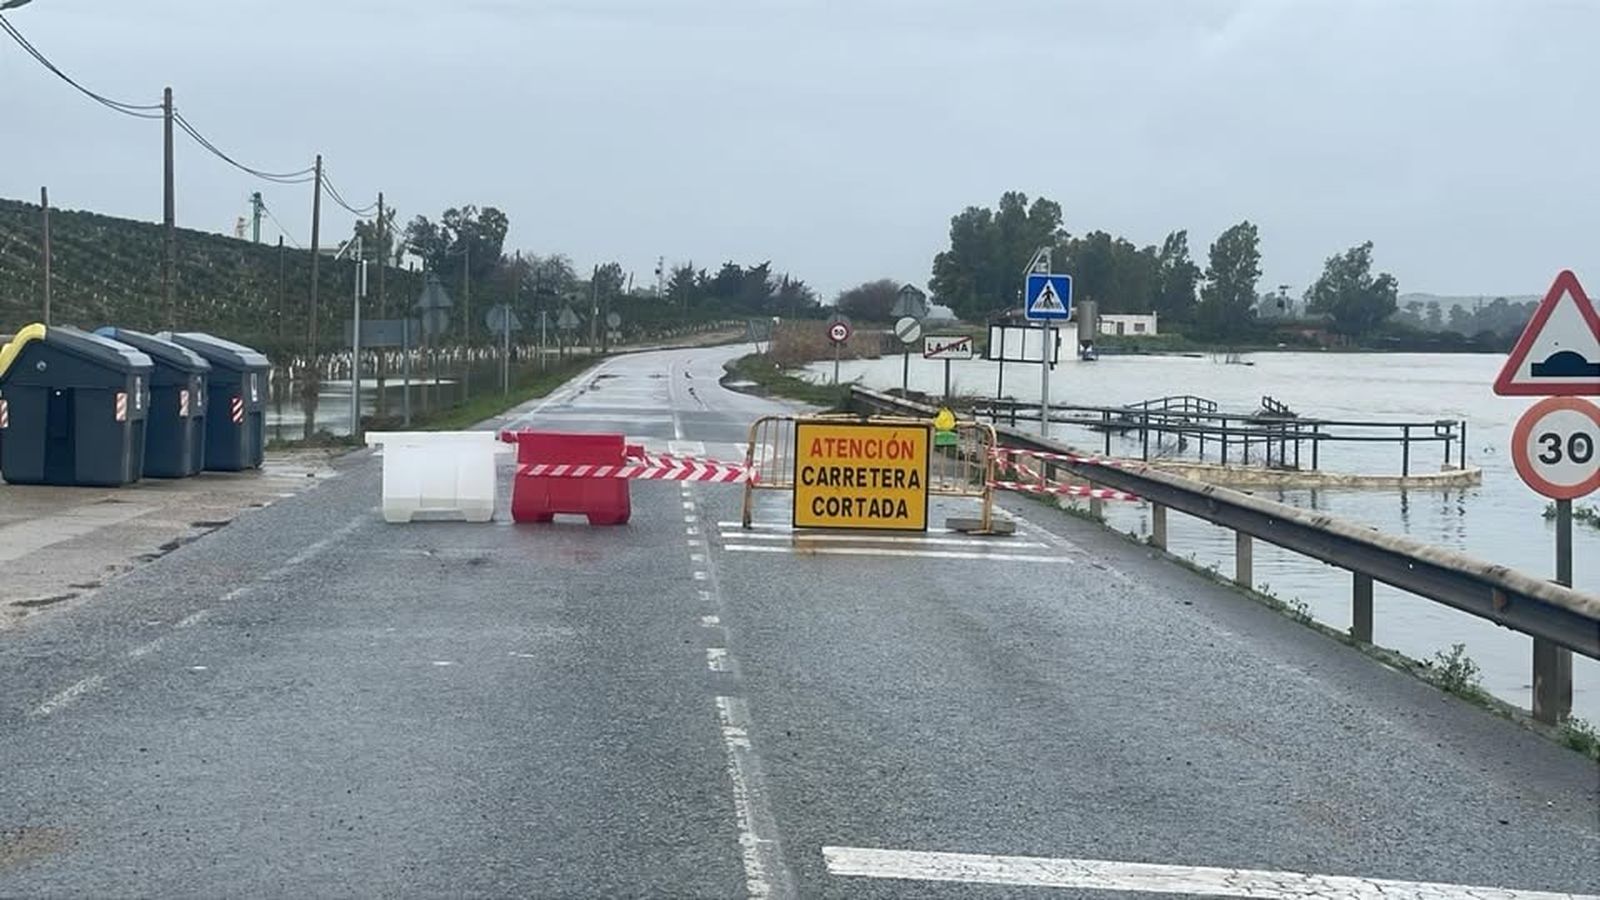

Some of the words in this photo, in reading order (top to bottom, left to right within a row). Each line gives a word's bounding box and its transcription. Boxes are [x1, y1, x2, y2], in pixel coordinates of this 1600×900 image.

[927, 342, 943, 352] LA
[810, 432, 914, 460] ATENCIÓN
[1538, 432, 1594, 465] 30
[802, 466, 920, 489] CARRETERA
[812, 496, 908, 519] CORTADA
